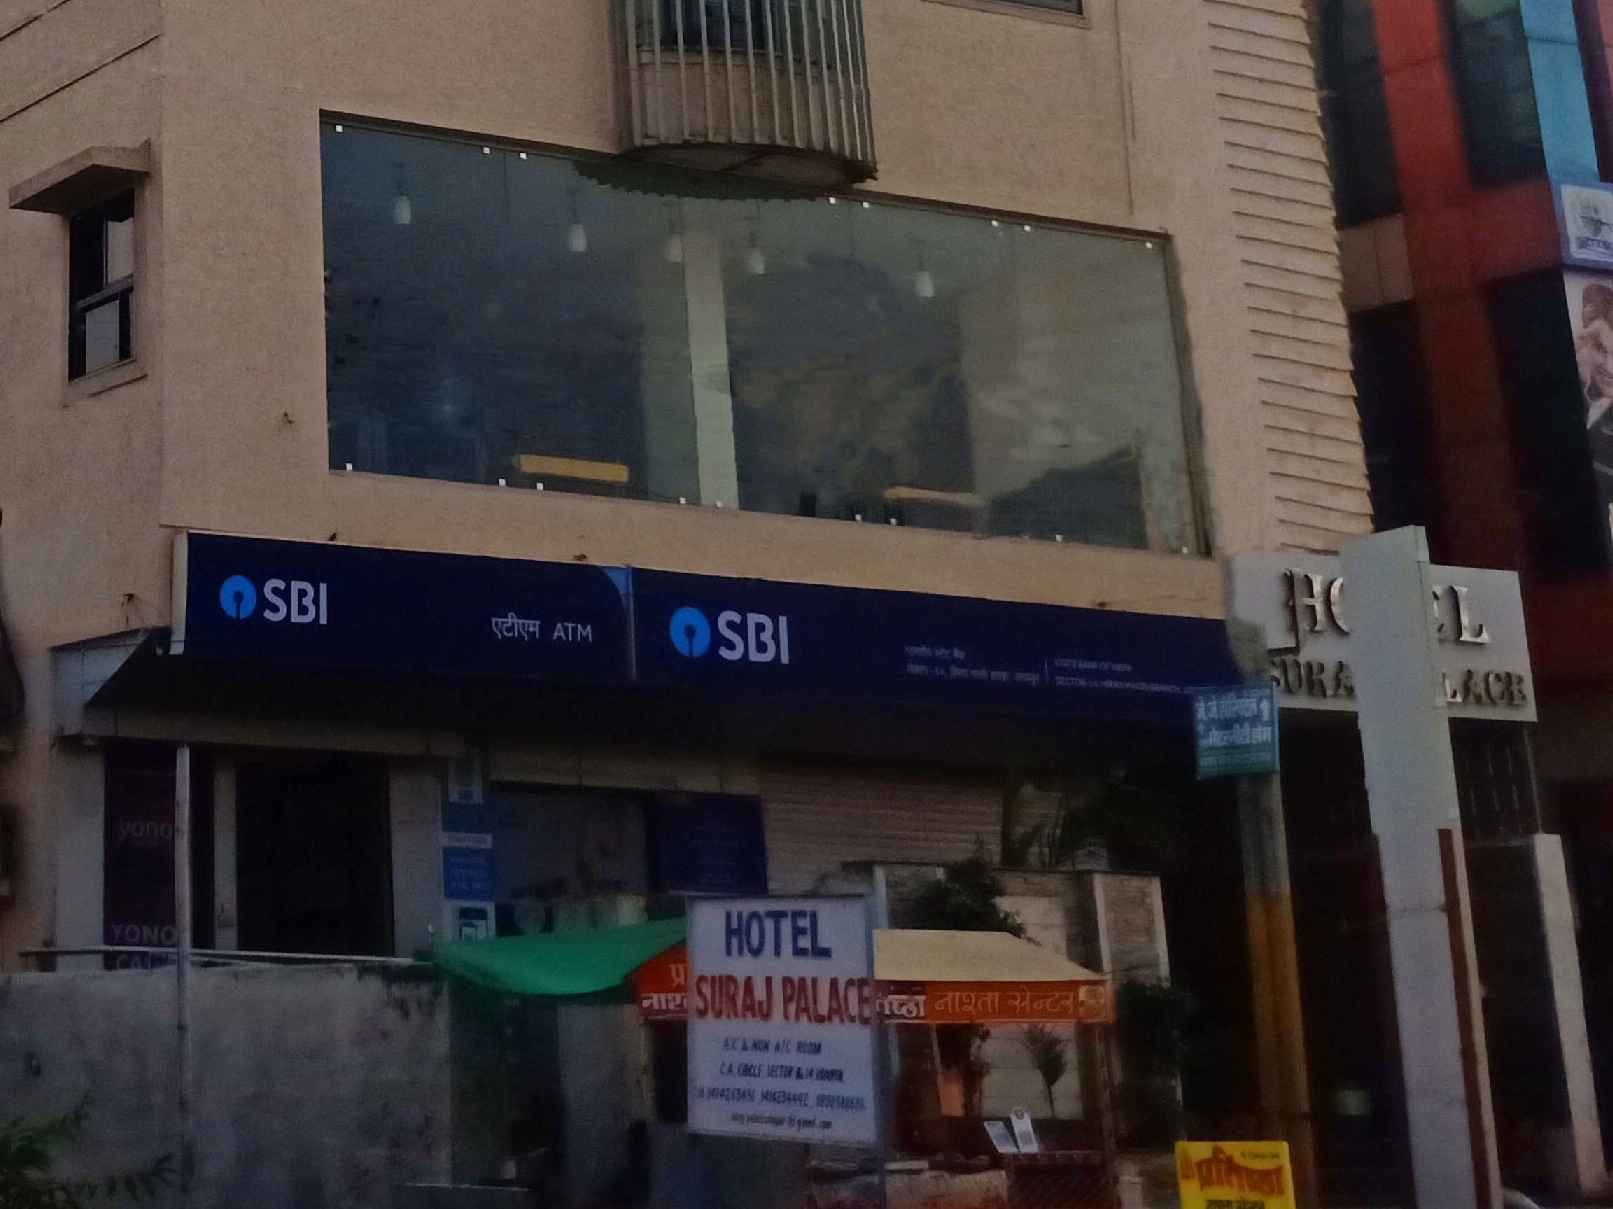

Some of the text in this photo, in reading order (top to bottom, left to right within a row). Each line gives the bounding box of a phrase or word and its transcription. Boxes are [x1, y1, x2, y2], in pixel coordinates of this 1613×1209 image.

[262, 577, 328, 625] SBI
[491, 612, 593, 643] एटीएम ATM
[717, 610, 790, 665] SBI
[1270, 658, 1528, 706] SURA LACE
[117, 818, 174, 842] yono
[112, 924, 177, 945] YONO
[724, 910, 833, 958] HOTEL
[696, 974, 873, 1025] SURAJ PALACE
[934, 989, 999, 1015] नाश्ता
